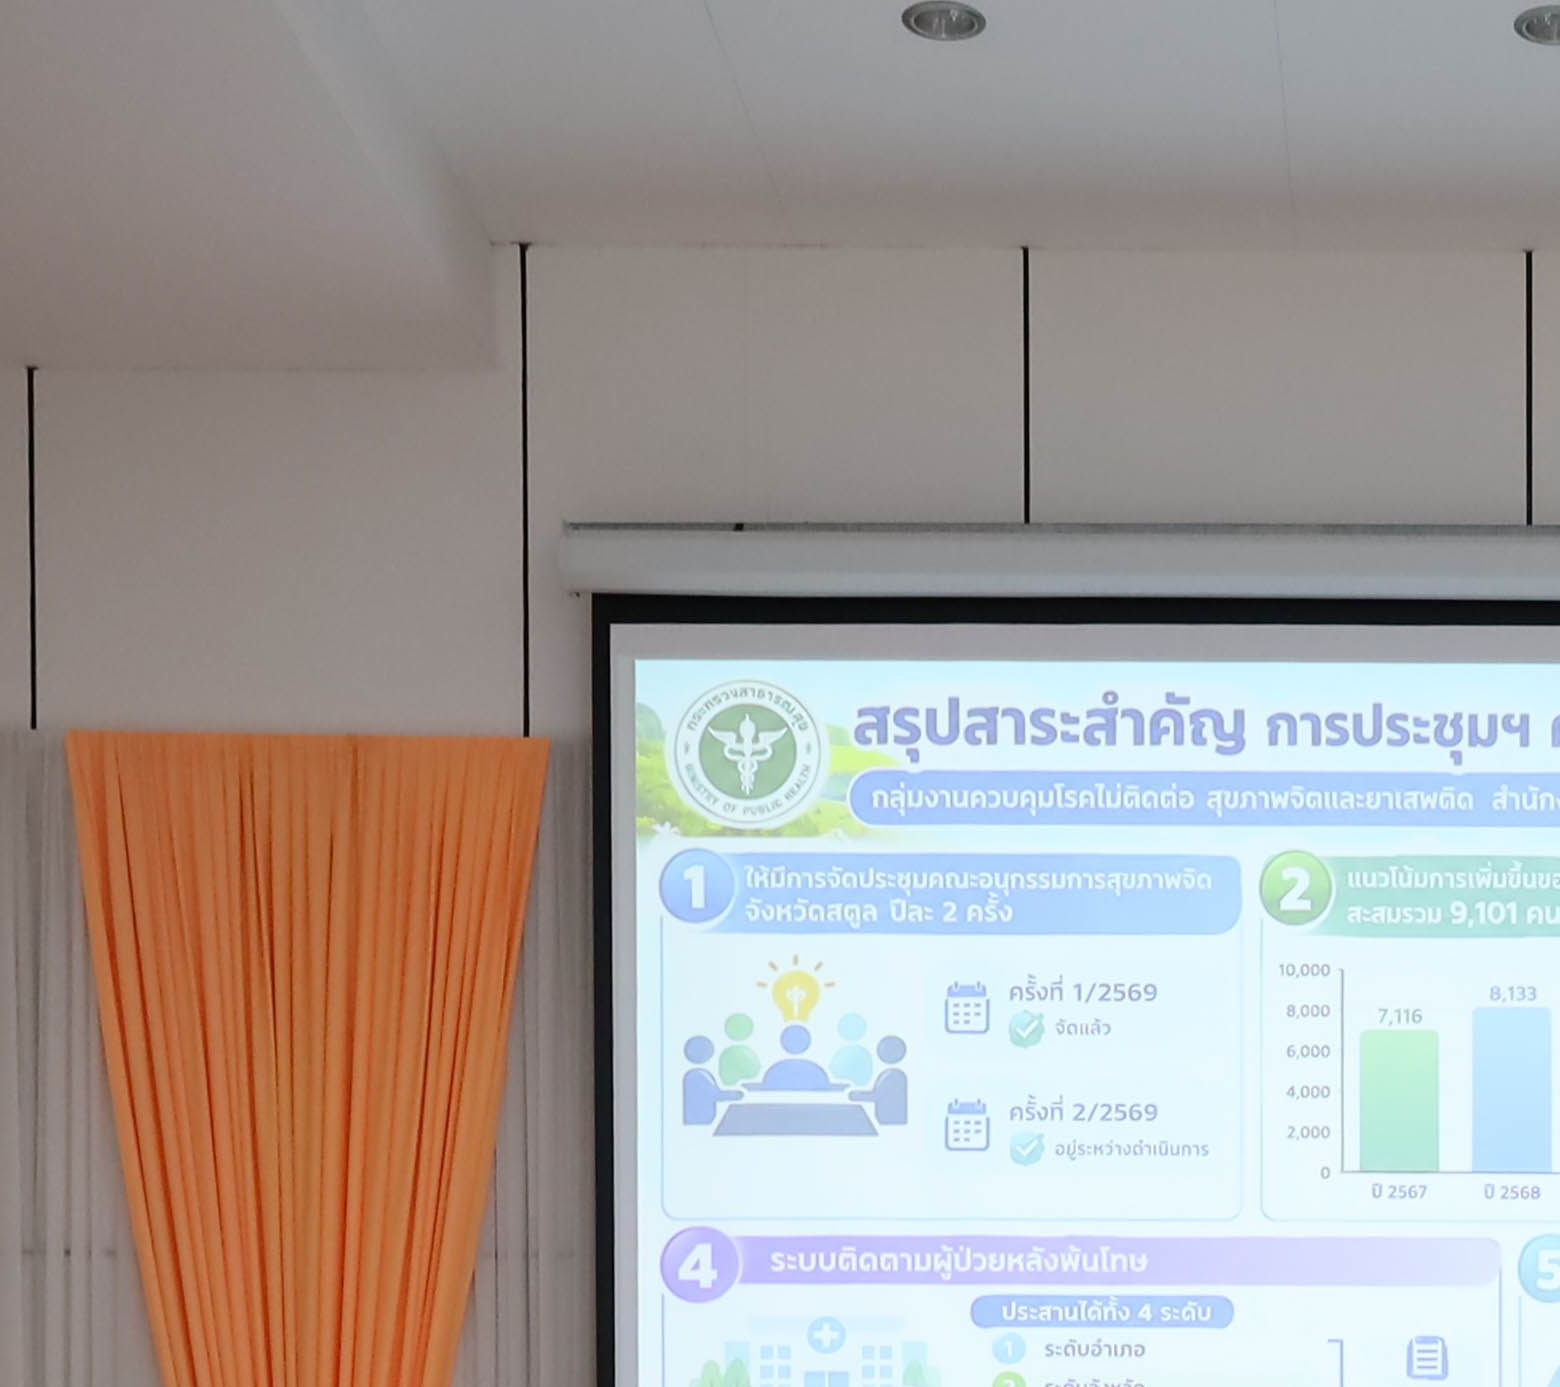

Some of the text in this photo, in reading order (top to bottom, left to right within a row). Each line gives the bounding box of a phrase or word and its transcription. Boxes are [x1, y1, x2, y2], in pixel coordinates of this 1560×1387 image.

[853, 690, 1247, 764] สรุปสาระสำคัญ
[1266, 702, 1531, 766] การประชุมฯ
[872, 782, 1195, 819] กลุ่มงานควบคุมโรคไม่ติดต่อ
[1207, 784, 1474, 818] สุขภาพจิตและยาเสพติด
[683, 865, 706, 909] 1
[745, 865, 1213, 898] ให้มีการจัดประชุมคณะอนุกรรมการสุขภาพจิต
[1279, 867, 1312, 910] 2
[745, 891, 1013, 930] จังหวัดสตูล ปีละ 2 ครั้ง
[1347, 907, 1442, 926] สะสมรวม
[1450, 901, 1518, 930] 9,101
[1278, 962, 1331, 980] 10,000
[1009, 973, 1158, 1005] ครั้งที่ 1/2569
[1489, 985, 1537, 1004] 8,133
[1286, 1003, 1331, 1021] 8,000
[1378, 1008, 1423, 1027] 7,116
[1055, 1016, 1112, 1037] จัดแล้ว
[1286, 1043, 1331, 1062] 6,000
[1286, 1084, 1331, 1102] 4,000
[1009, 1094, 1159, 1125] ครั้งที่ 2/2569
[1286, 1124, 1331, 1142] 2,000
[1055, 1138, 1210, 1163] อยู่ระหว่างดำเนินการ
[1321, 1165, 1331, 1179] 0
[1371, 1181, 1428, 1200] ปี 2567
[1483, 1182, 1541, 1201] ปี 2568
[678, 1243, 718, 1289] 4
[771, 1244, 1149, 1280] ระบบติดตามผู้ป่วยหลังพ้นโทษ
[1002, 1295, 1212, 1322] ประสานได้ทั้ง 4 ระดับ
[1044, 1338, 1146, 1358] ระดับอำเภอ
